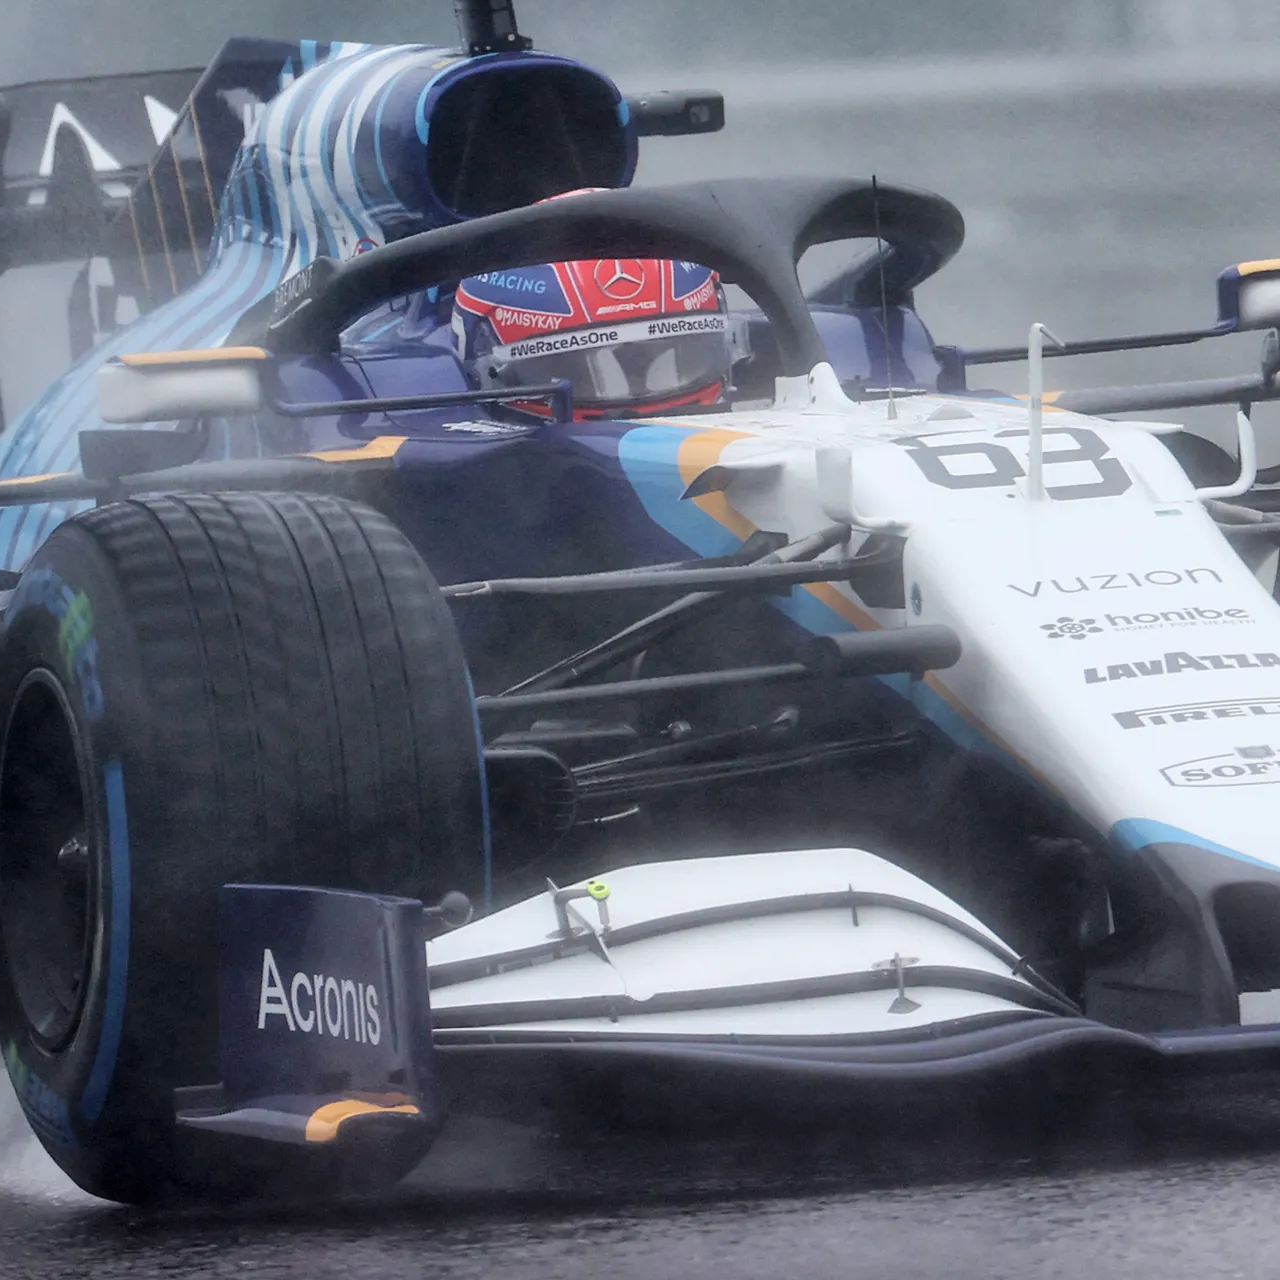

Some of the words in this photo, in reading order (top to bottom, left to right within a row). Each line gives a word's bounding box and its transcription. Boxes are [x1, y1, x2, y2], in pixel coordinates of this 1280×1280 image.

[488, 271, 547, 295] RACING
[494, 307, 563, 331] @MAISYKAY
[510, 330, 619, 358] #WeRaceAsOne
[889, 427, 1133, 501] 63
[1104, 607, 1250, 627] honibe
[257, 948, 381, 1046] Acronis
